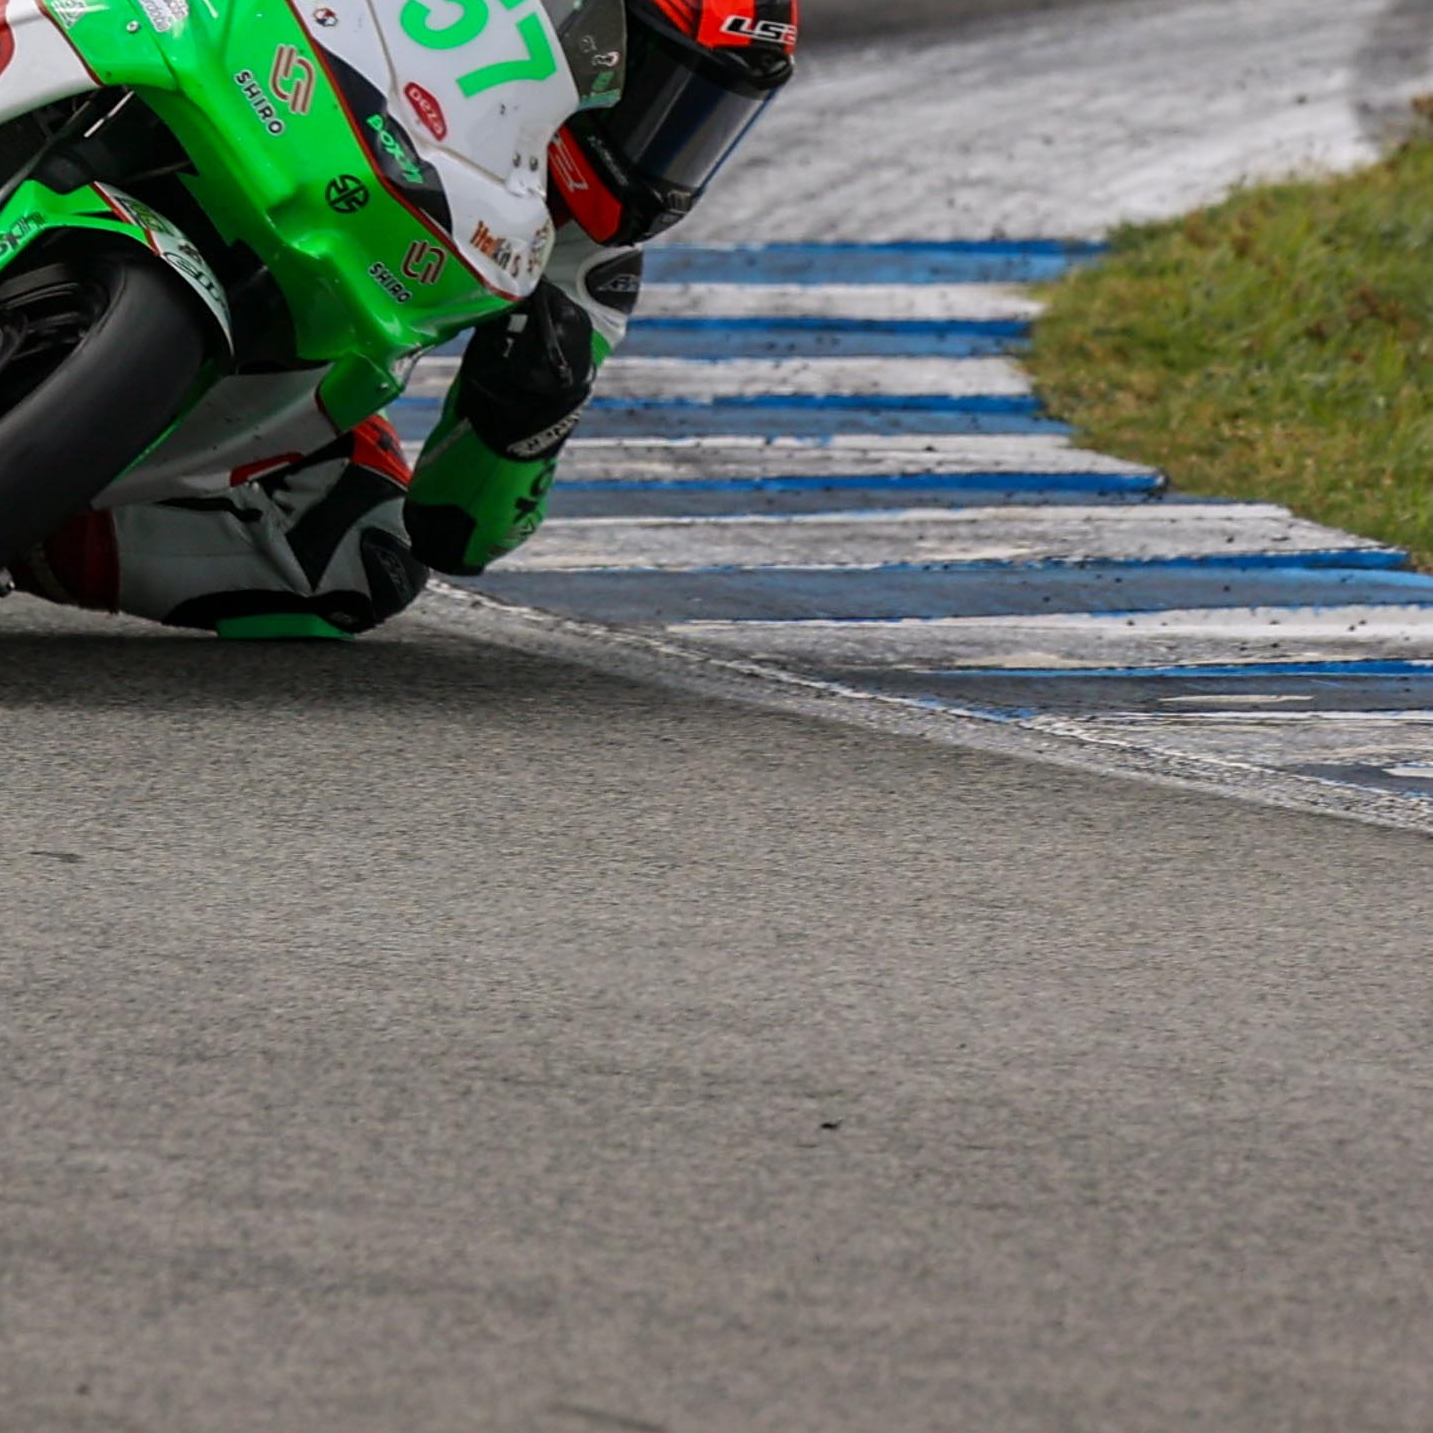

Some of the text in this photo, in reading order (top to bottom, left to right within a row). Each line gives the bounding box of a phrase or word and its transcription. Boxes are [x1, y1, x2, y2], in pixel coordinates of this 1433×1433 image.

[721, 15, 797, 46] LS2
[236, 70, 284, 135] SHIRO
[369, 263, 411, 303] SHIRO
